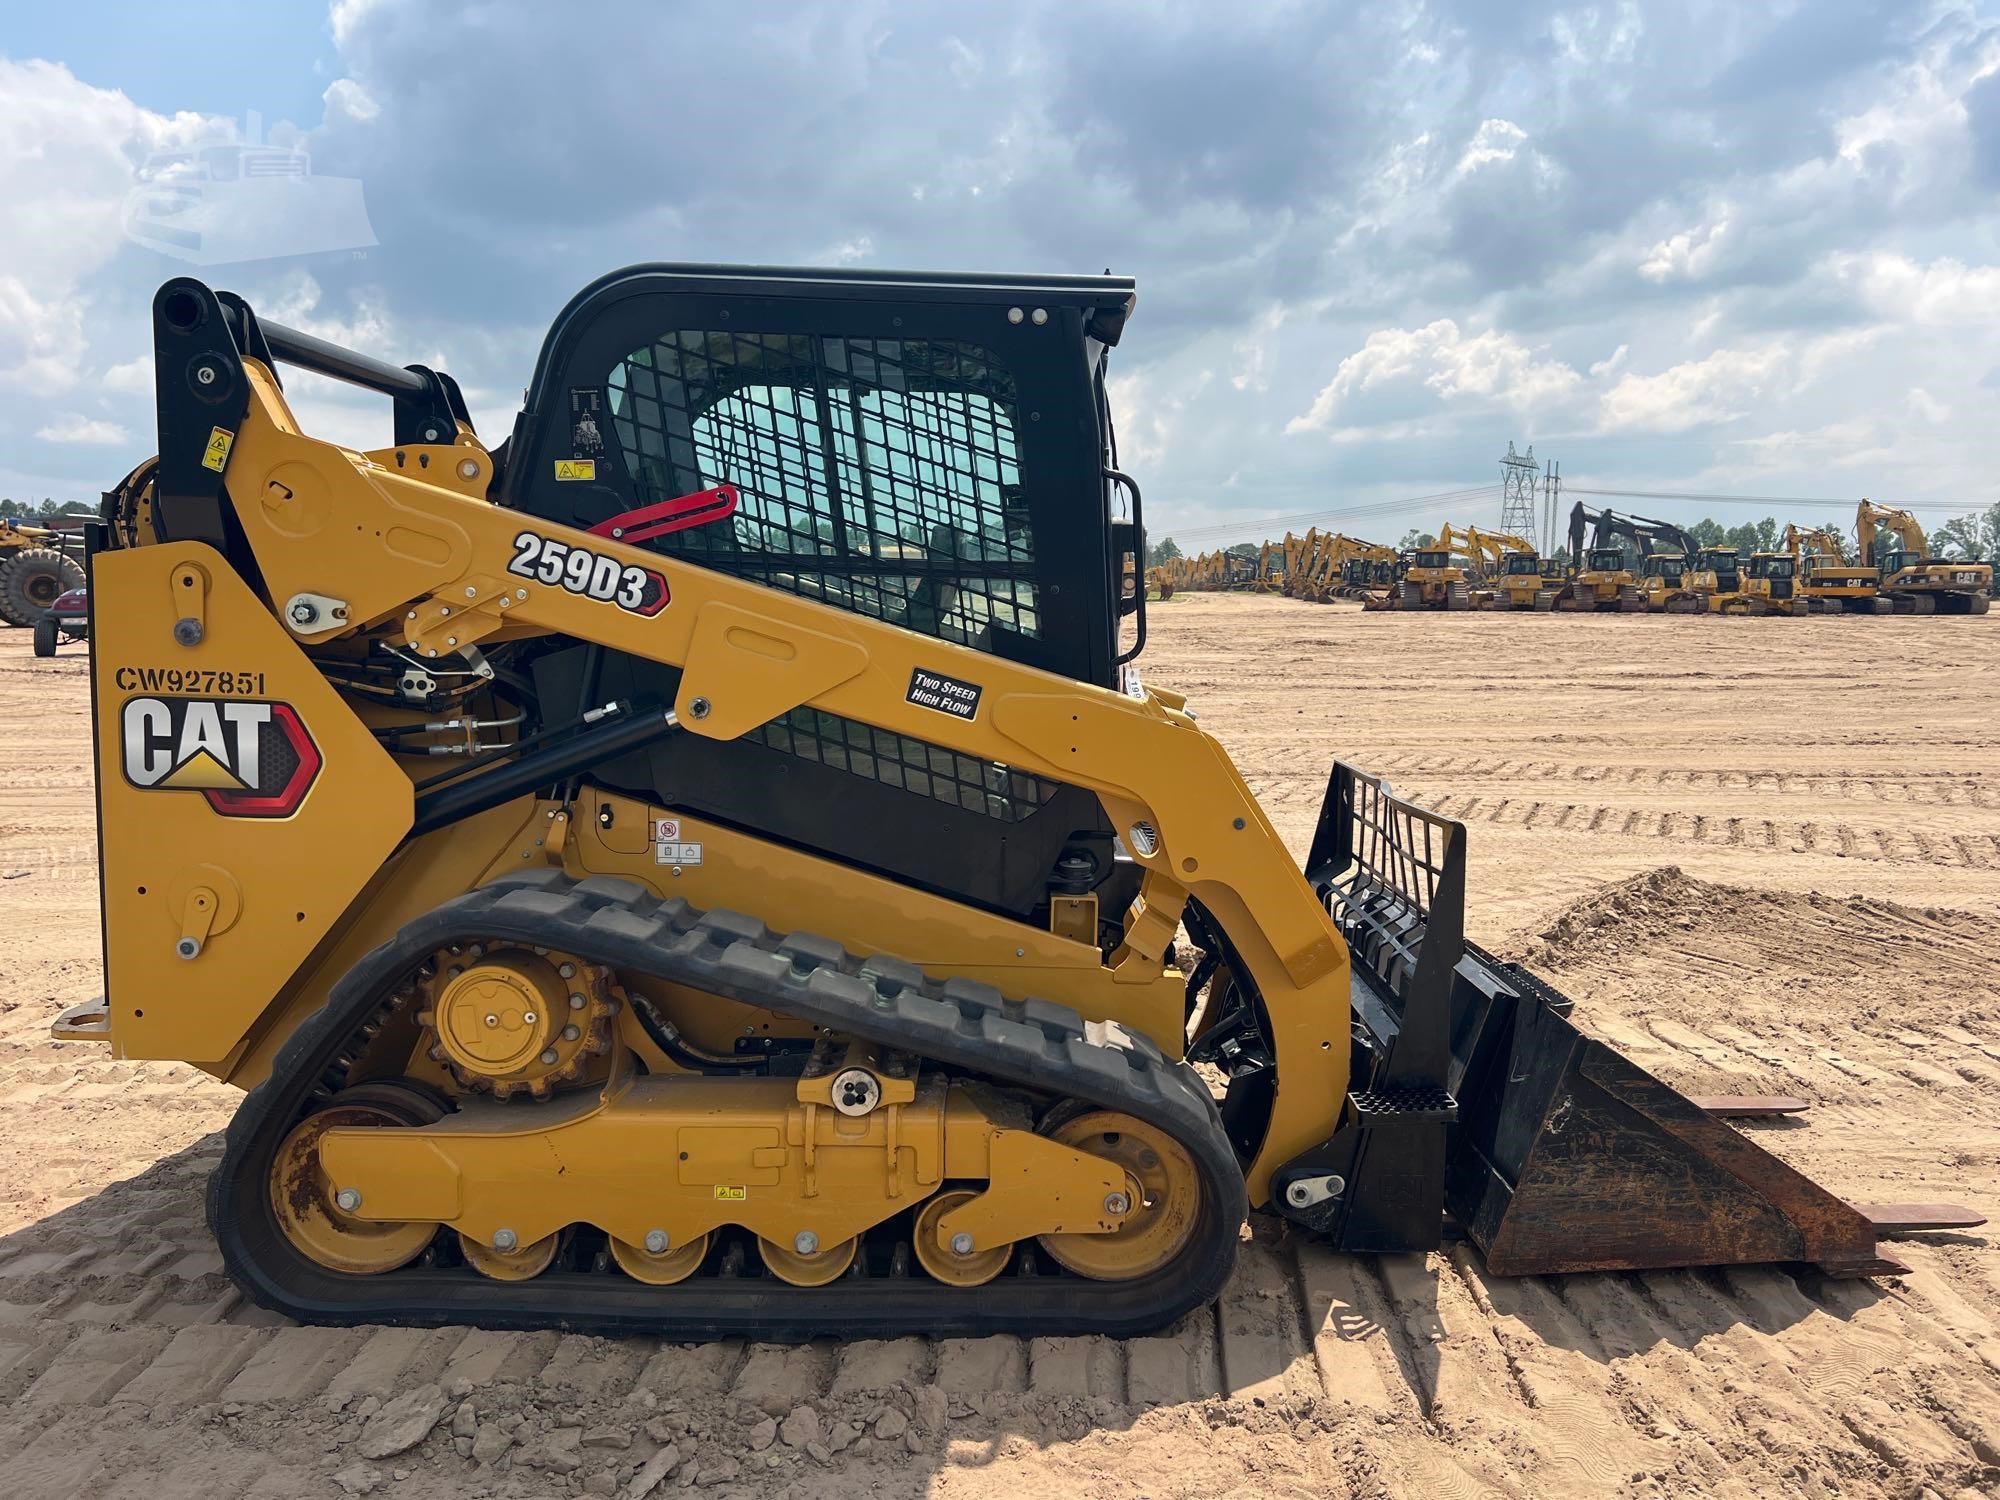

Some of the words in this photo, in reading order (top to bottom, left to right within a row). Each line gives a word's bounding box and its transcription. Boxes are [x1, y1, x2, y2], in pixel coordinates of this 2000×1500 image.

[512, 532, 648, 609] 259D3
[1847, 578, 1862, 588] CAT
[1956, 572, 1976, 583] CAT
[115, 667, 266, 695] CW927851
[915, 673, 940, 690] TWO
[941, 681, 976, 701] SPEED
[910, 688, 940, 706] HIGH
[940, 697, 971, 715] FLOW
[125, 698, 271, 790] CAT
